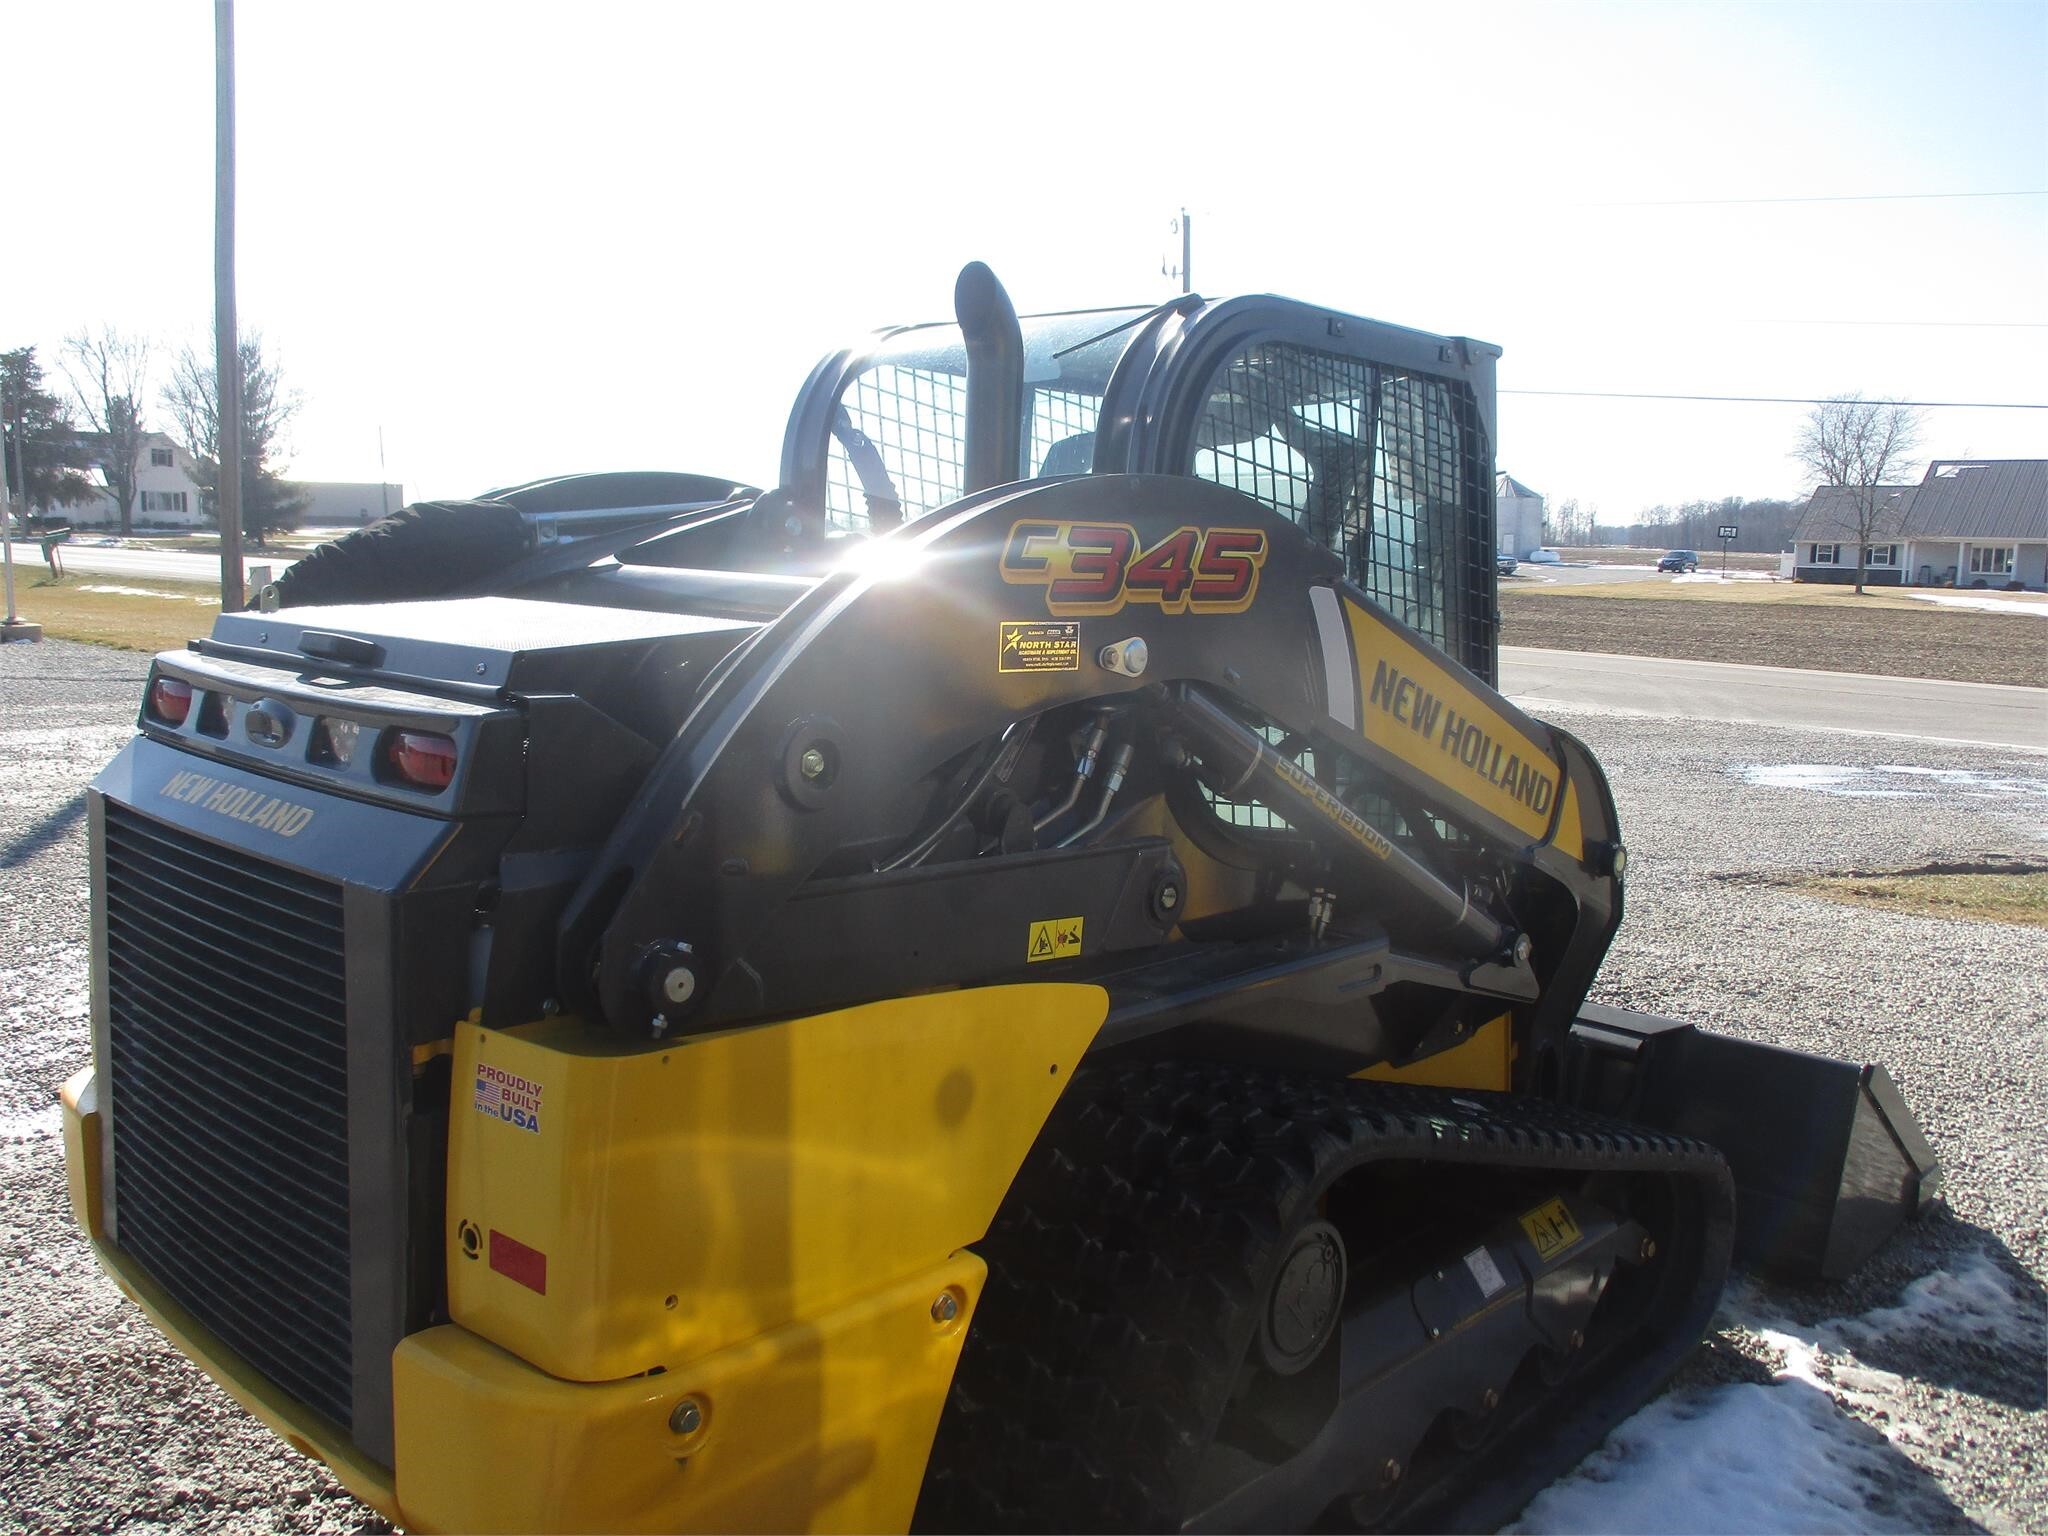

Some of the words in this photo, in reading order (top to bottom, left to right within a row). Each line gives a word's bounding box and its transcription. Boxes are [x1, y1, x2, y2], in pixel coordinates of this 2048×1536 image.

[1019, 641, 1052, 649] NORTH
[1053, 640, 1077, 649] STAR
[1370, 659, 1442, 740] NEW
[1440, 708, 1553, 816] HOLLAND
[159, 770, 218, 804] NEW
[202, 782, 314, 837] HOLLAND
[477, 1063, 542, 1097] PROUDLY
[475, 1101, 483, 1111] in
[484, 1104, 499, 1117] the
[500, 1103, 539, 1133] USA
[502, 1088, 541, 1113] BUILT
